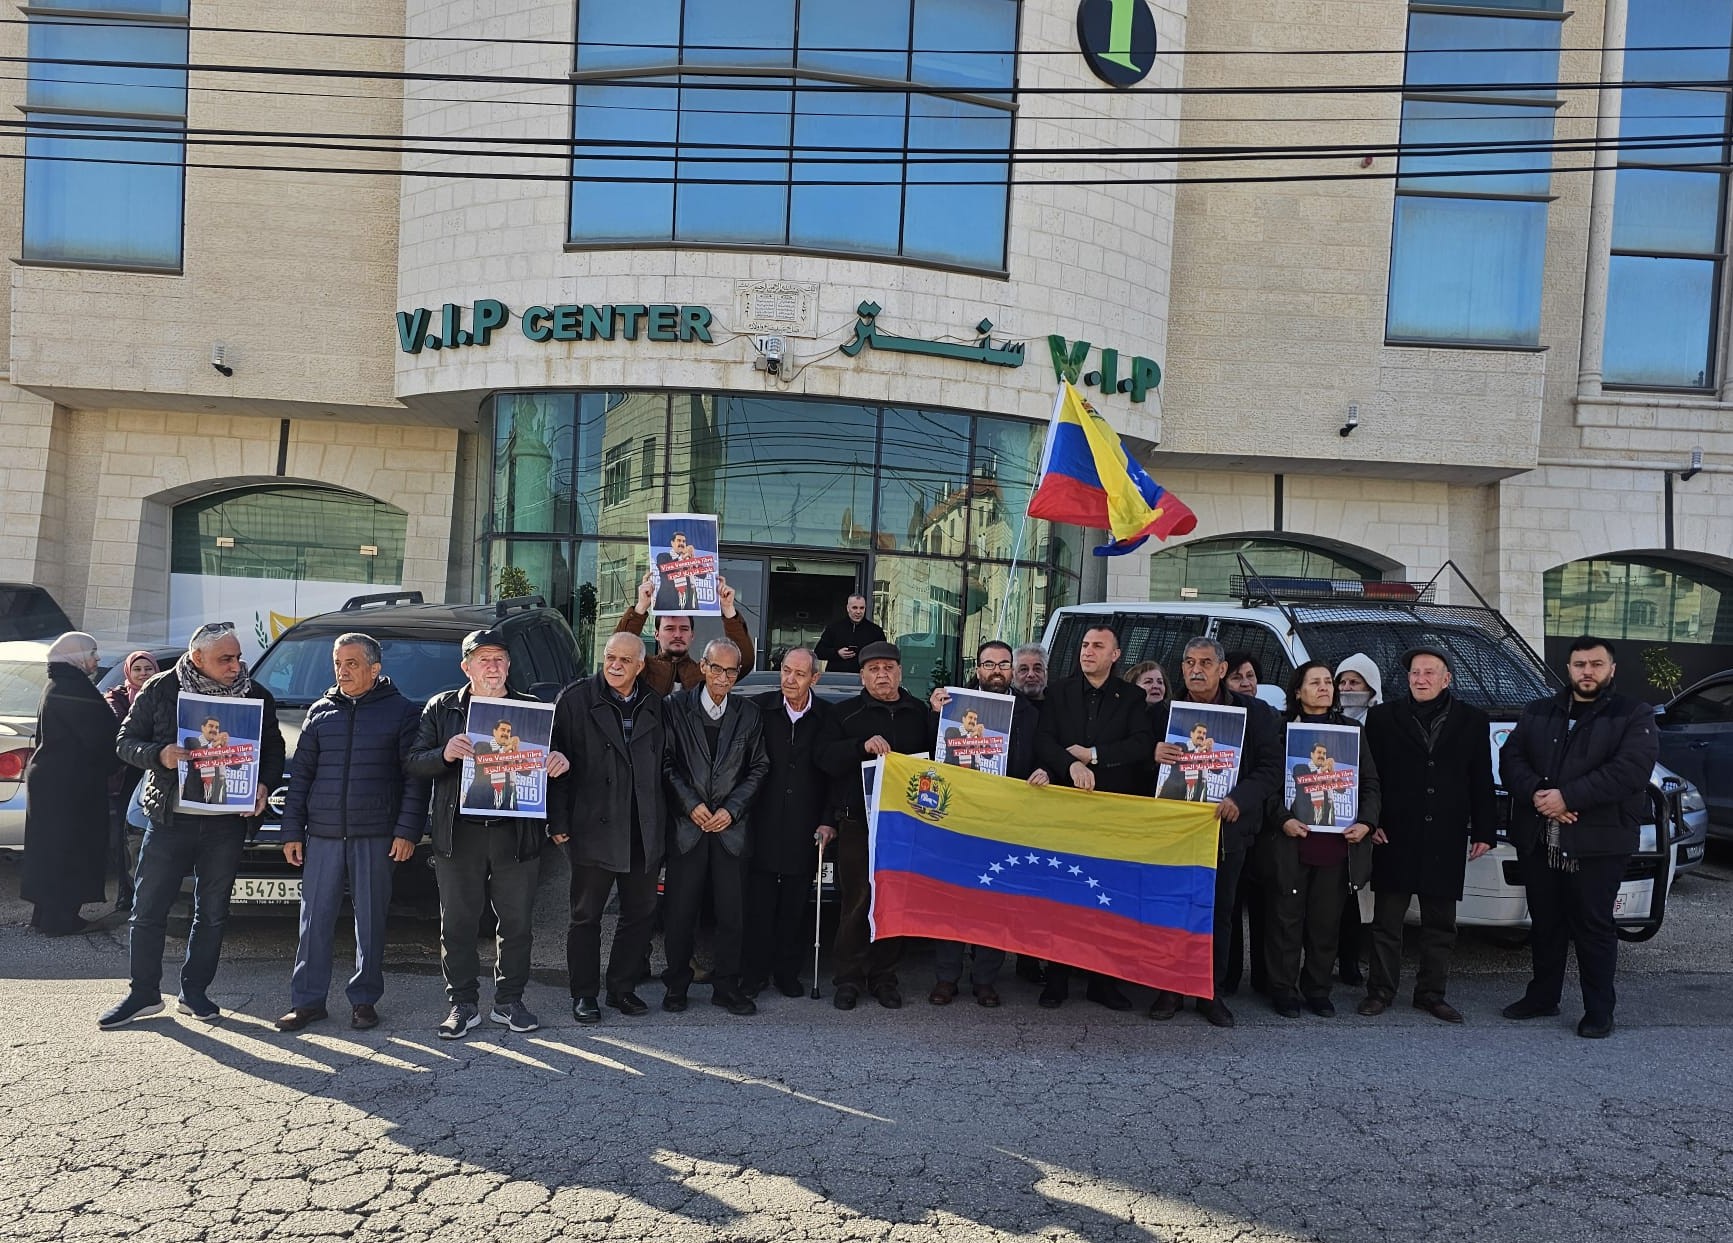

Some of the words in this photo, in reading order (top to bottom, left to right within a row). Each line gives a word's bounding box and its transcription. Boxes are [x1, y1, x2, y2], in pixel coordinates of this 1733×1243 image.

[396, 299, 509, 354] V.I.P
[521, 304, 714, 343] CENTER
[839, 300, 1025, 368] سنتر
[1047, 334, 1161, 403] V.I.P
